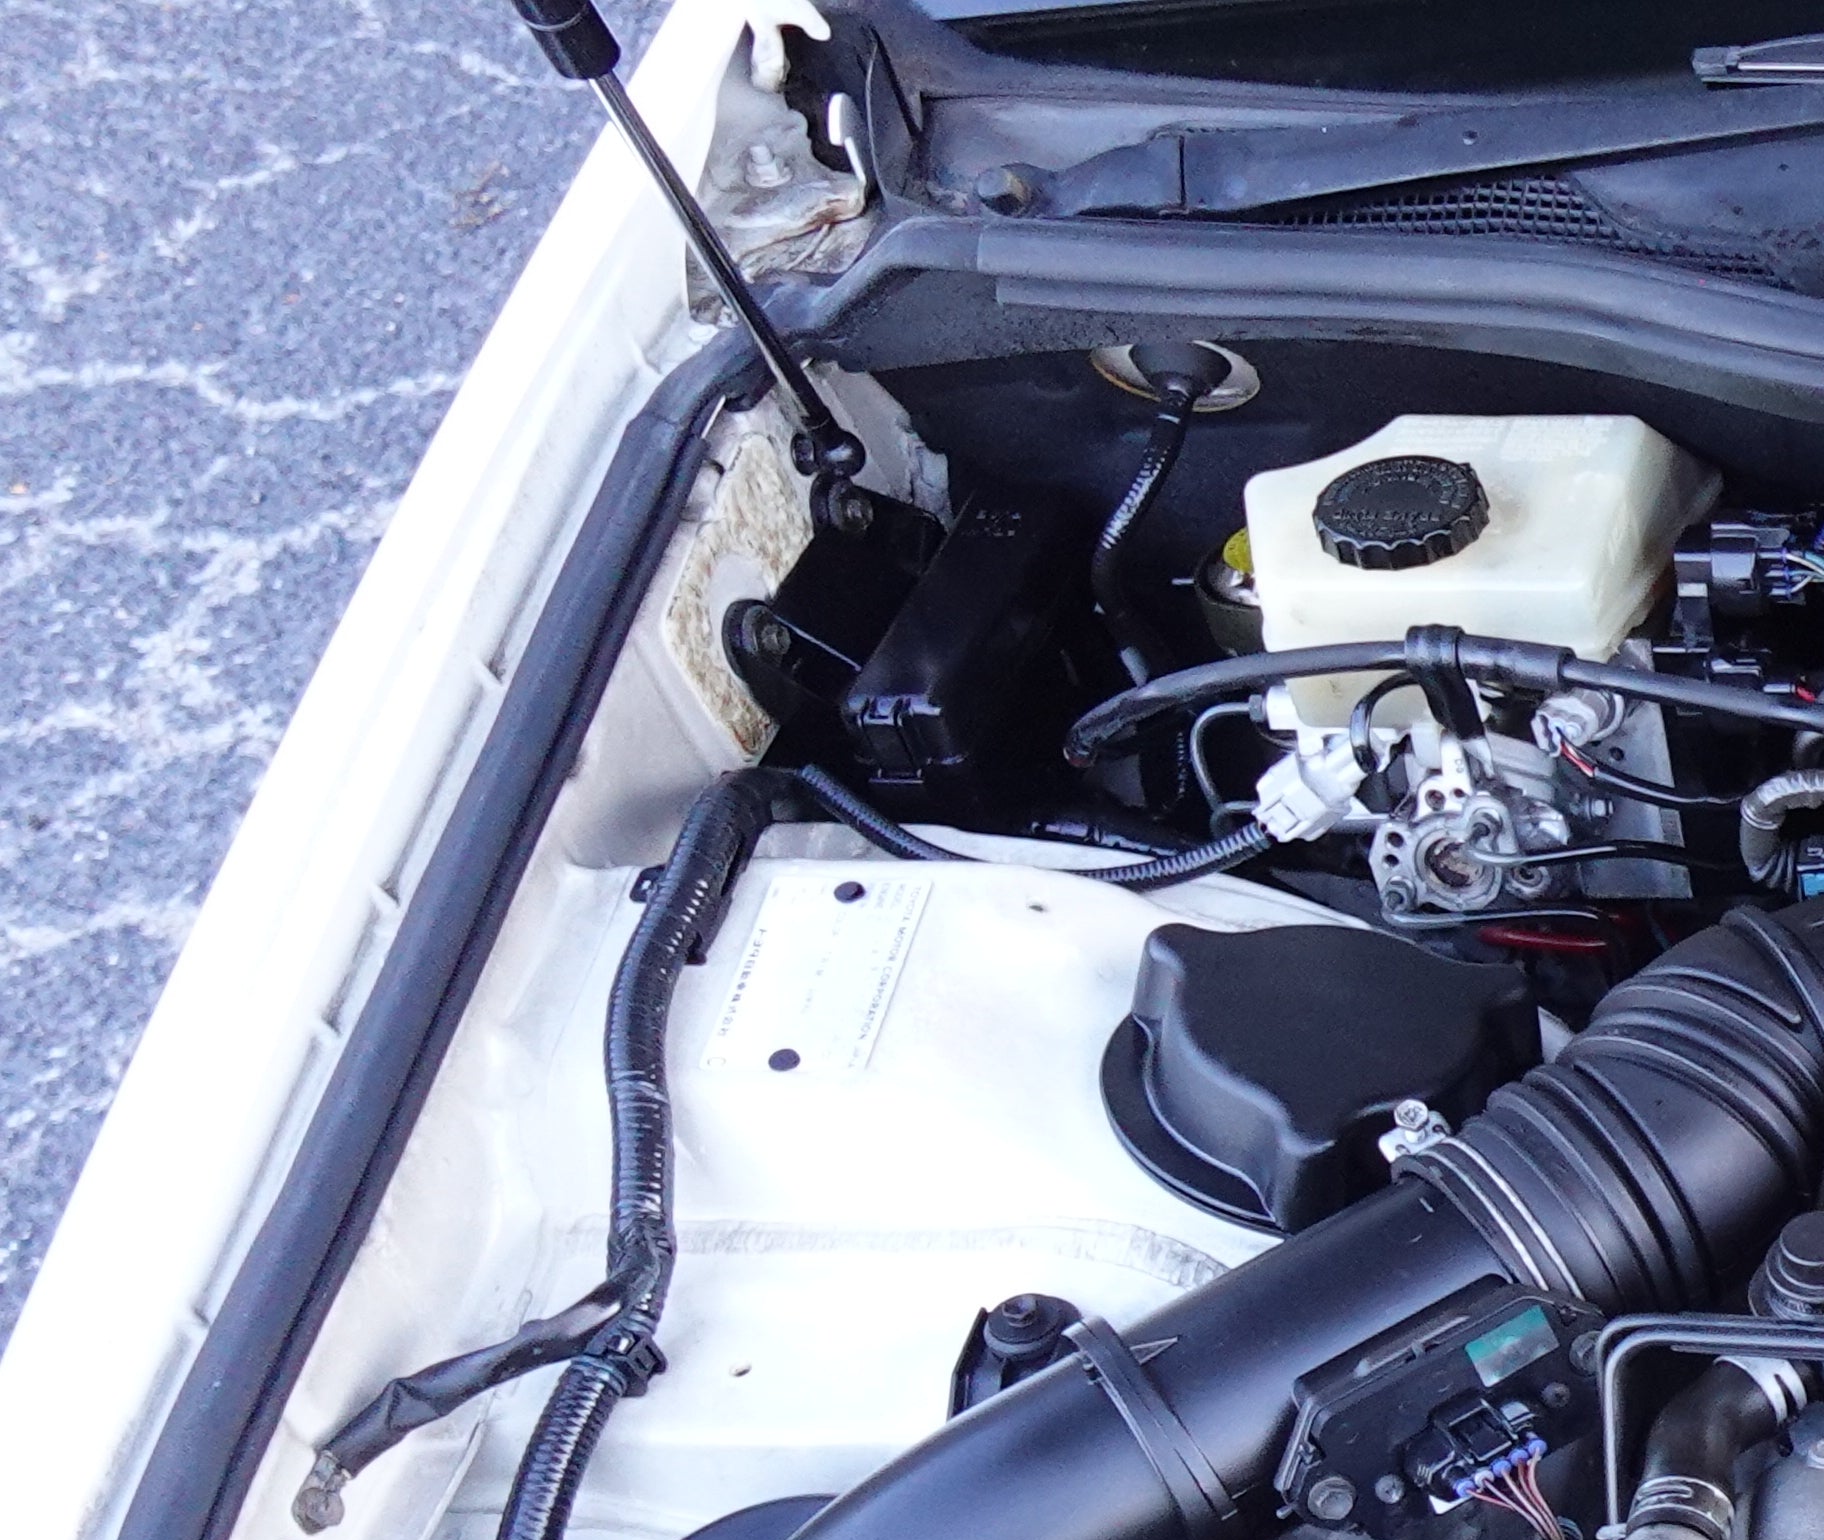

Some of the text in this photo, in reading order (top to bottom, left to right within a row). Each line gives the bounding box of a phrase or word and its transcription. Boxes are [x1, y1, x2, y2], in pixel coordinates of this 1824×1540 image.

[905, 886, 923, 921] TOYOTA
[891, 926, 908, 966] MOTOR
[857, 966, 896, 1041] CORPORATION
